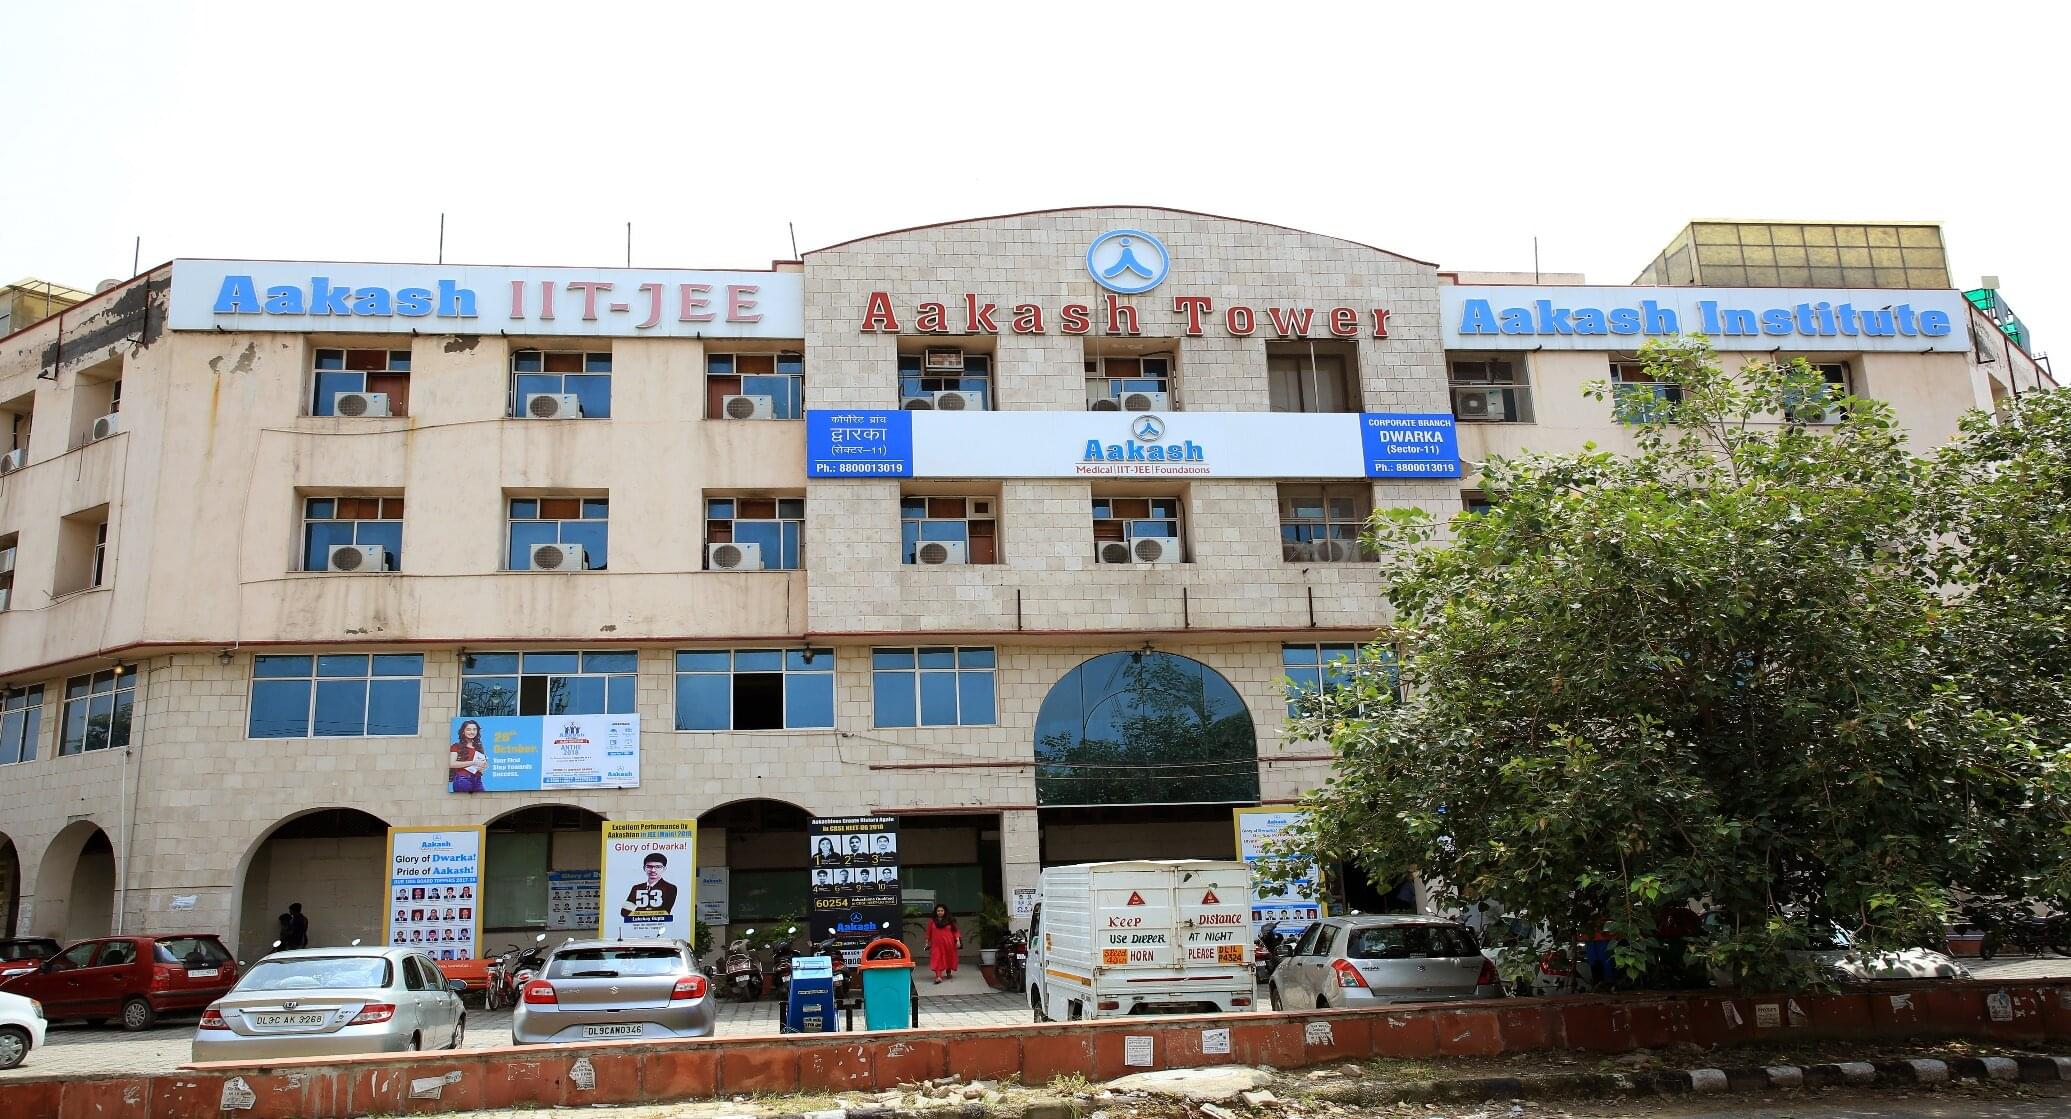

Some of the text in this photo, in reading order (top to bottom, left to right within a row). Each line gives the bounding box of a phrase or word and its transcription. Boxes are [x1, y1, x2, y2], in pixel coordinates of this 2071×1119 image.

[213, 275, 764, 328] Aakash IIT-JEE
[860, 291, 1392, 339] Aakash Tower
[1458, 298, 1952, 338] Aakash Institute
[1368, 418, 1452, 427] CORPORATE BRANCH
[1380, 430, 1444, 443] DWARKA
[1083, 439, 1205, 462] Aakash
[1387, 444, 1440, 455] (Sector-11)
[839, 463, 903, 473] 8800013019
[1396, 463, 1455, 472] 8800013019
[615, 842, 687, 852] Glory of Dwarka!
[395, 853, 477, 865] Glory of Dwarka!
[396, 866, 474, 876] Pride of Aakash!
[635, 889, 664, 908] 53
[816, 898, 849, 908] 60254
[836, 921, 877, 932] Aakash
[1188, 932, 1201, 942] AT
[1205, 931, 1234, 941] NIGHT
[1130, 948, 1215, 962] HORN PLEASE
[283, 1016, 296, 1024] AK
[299, 1015, 322, 1023] 3268
